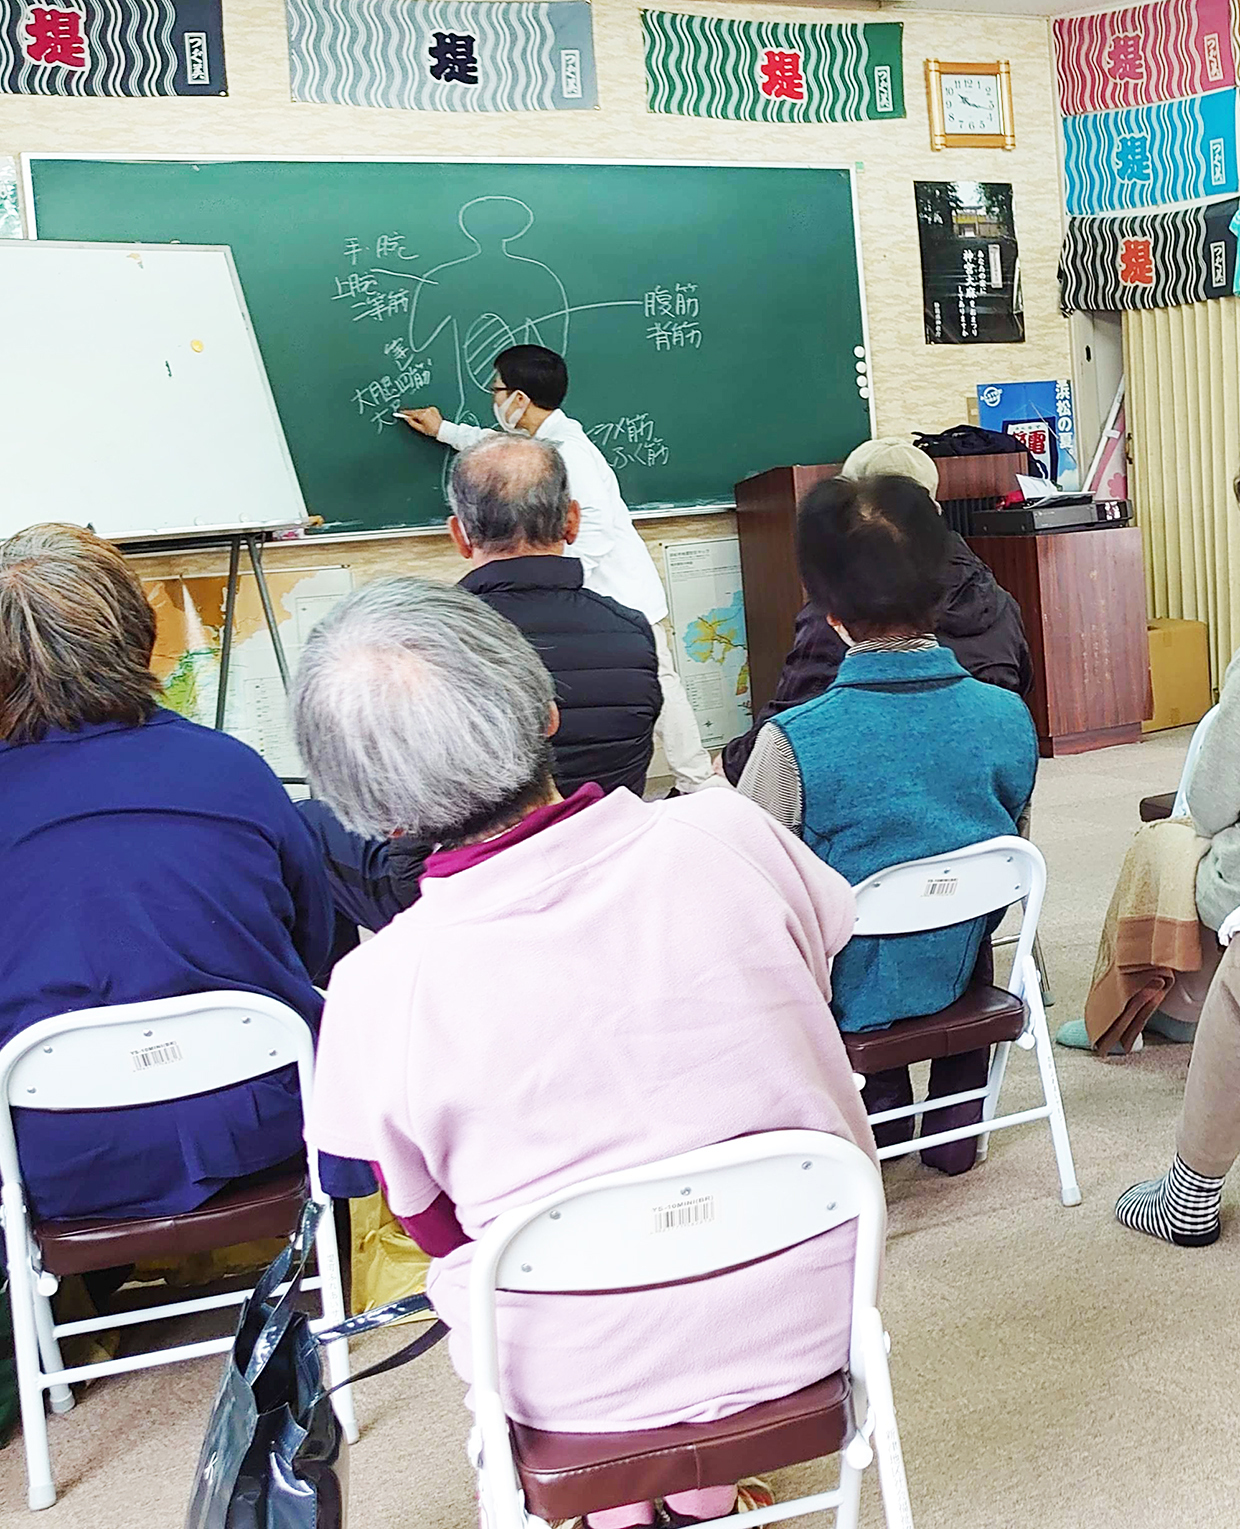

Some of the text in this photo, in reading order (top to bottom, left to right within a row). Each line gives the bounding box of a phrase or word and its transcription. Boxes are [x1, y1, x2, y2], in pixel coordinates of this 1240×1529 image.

[963, 79, 973, 89] 12
[977, 80, 981, 90] 1
[945, 87, 954, 96] 10
[985, 86, 991, 96] 2
[945, 100, 952, 109] 9
[948, 113, 955, 122] 8
[959, 120, 964, 129] 7
[968, 121, 975, 130] 6
[979, 120, 986, 129] 5
[645, 283, 699, 317] 腹筋
[646, 321, 702, 350] 背筋
[586, 412, 654, 445] ラメ筋
[608, 437, 669, 469] ふく筋
